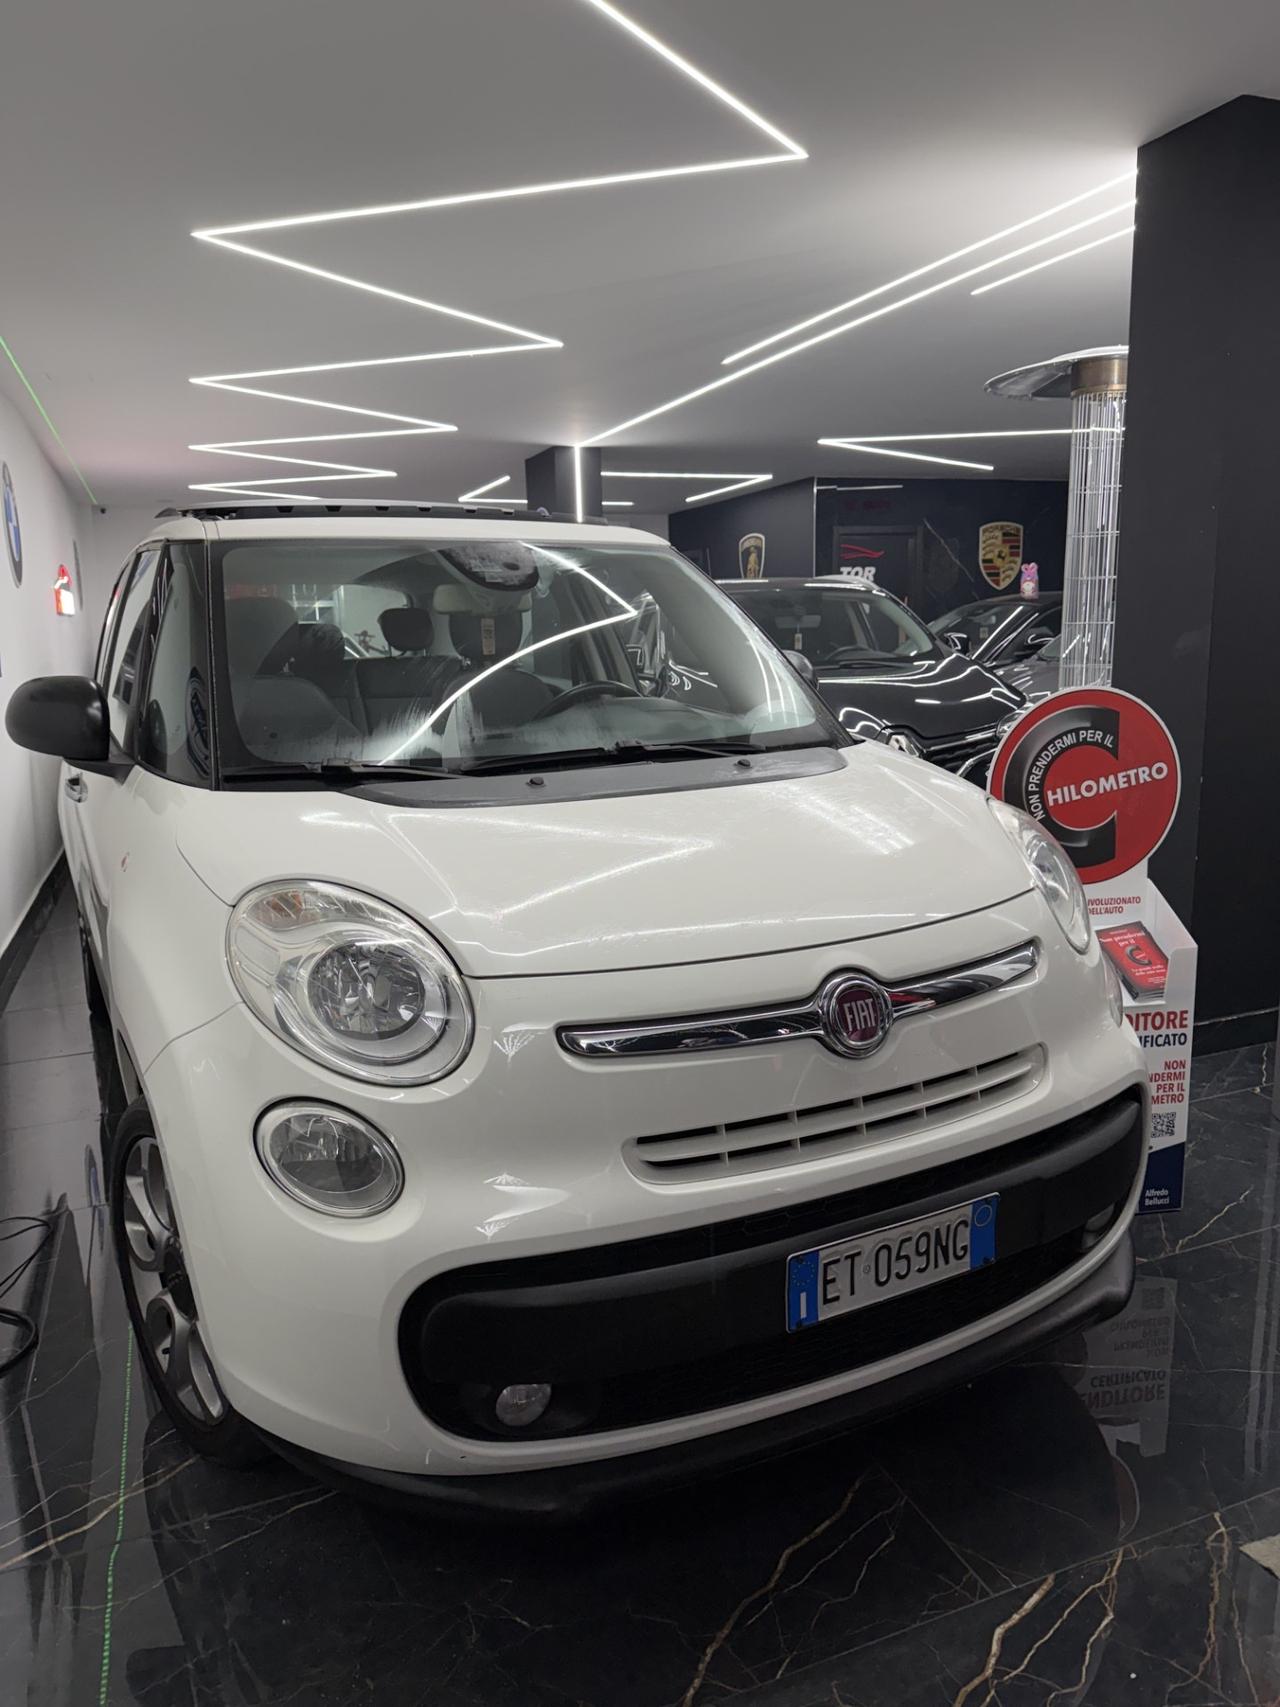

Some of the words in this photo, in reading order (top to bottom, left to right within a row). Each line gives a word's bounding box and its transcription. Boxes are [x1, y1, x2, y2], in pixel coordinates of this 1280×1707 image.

[1079, 730, 1103, 743] PER
[1104, 733, 1114, 748] IL
[1028, 732, 1077, 791] PRENDERMI
[1046, 761, 1168, 806] HILOMETRO
[1028, 795, 1046, 821] NON
[843, 998, 876, 1031] FIAT
[1164, 1060, 1186, 1070] NON
[1156, 1083, 1174, 1093] PER
[1177, 1083, 1185, 1092] IL
[1151, 1094, 1184, 1104] METRO
[822, 1251, 862, 1305] ET
[874, 1219, 969, 1287] 059NG
